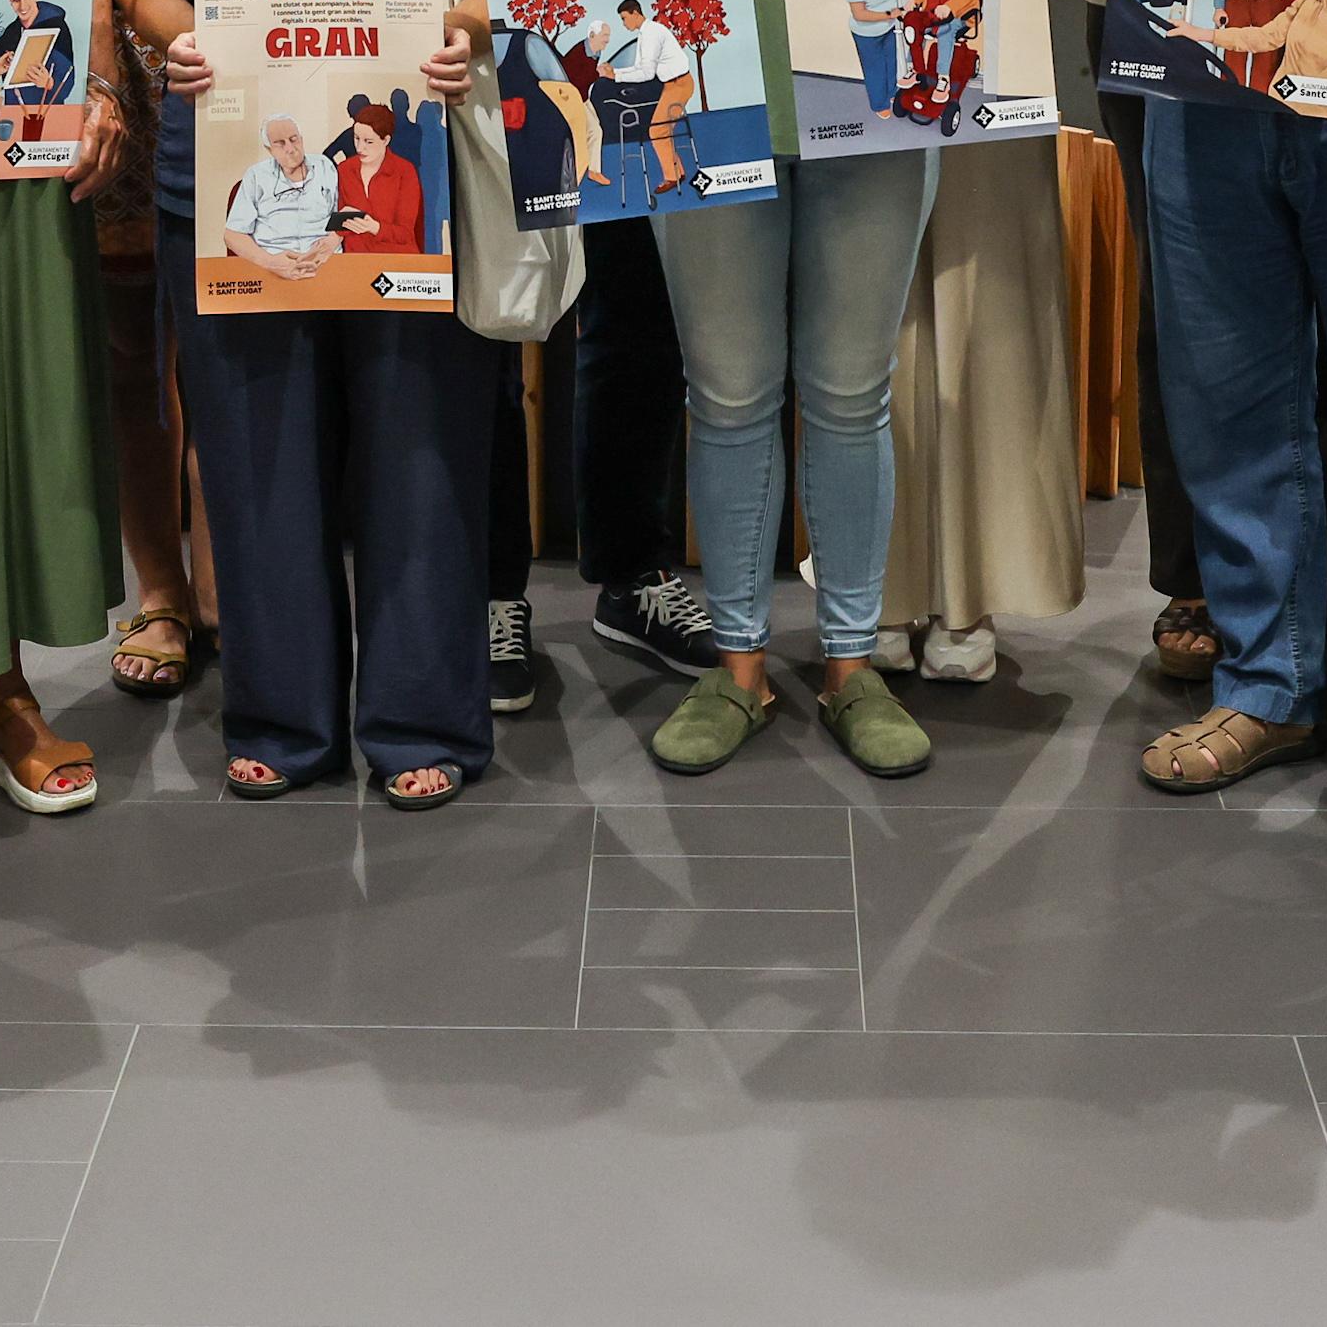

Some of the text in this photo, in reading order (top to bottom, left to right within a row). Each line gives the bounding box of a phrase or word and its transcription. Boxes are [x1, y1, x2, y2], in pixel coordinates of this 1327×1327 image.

[266, 27, 379, 58] GRAN
[1118, 61, 1166, 73] SANT CUGAT
[1118, 69, 1166, 80] SANT CUGAT
[998, 110, 1045, 121] SantCugat
[817, 122, 864, 133] SANT CUGAT
[818, 129, 864, 140] SANT CUGAT
[27, 153, 70, 162] SantCugat
[716, 174, 763, 186] SantCugat
[533, 191, 580, 204] SANT CUGAT
[534, 199, 581, 212] SANT CUGAT
[237, 280, 262, 288] CUGAT
[396, 285, 441, 295] SantCugat
